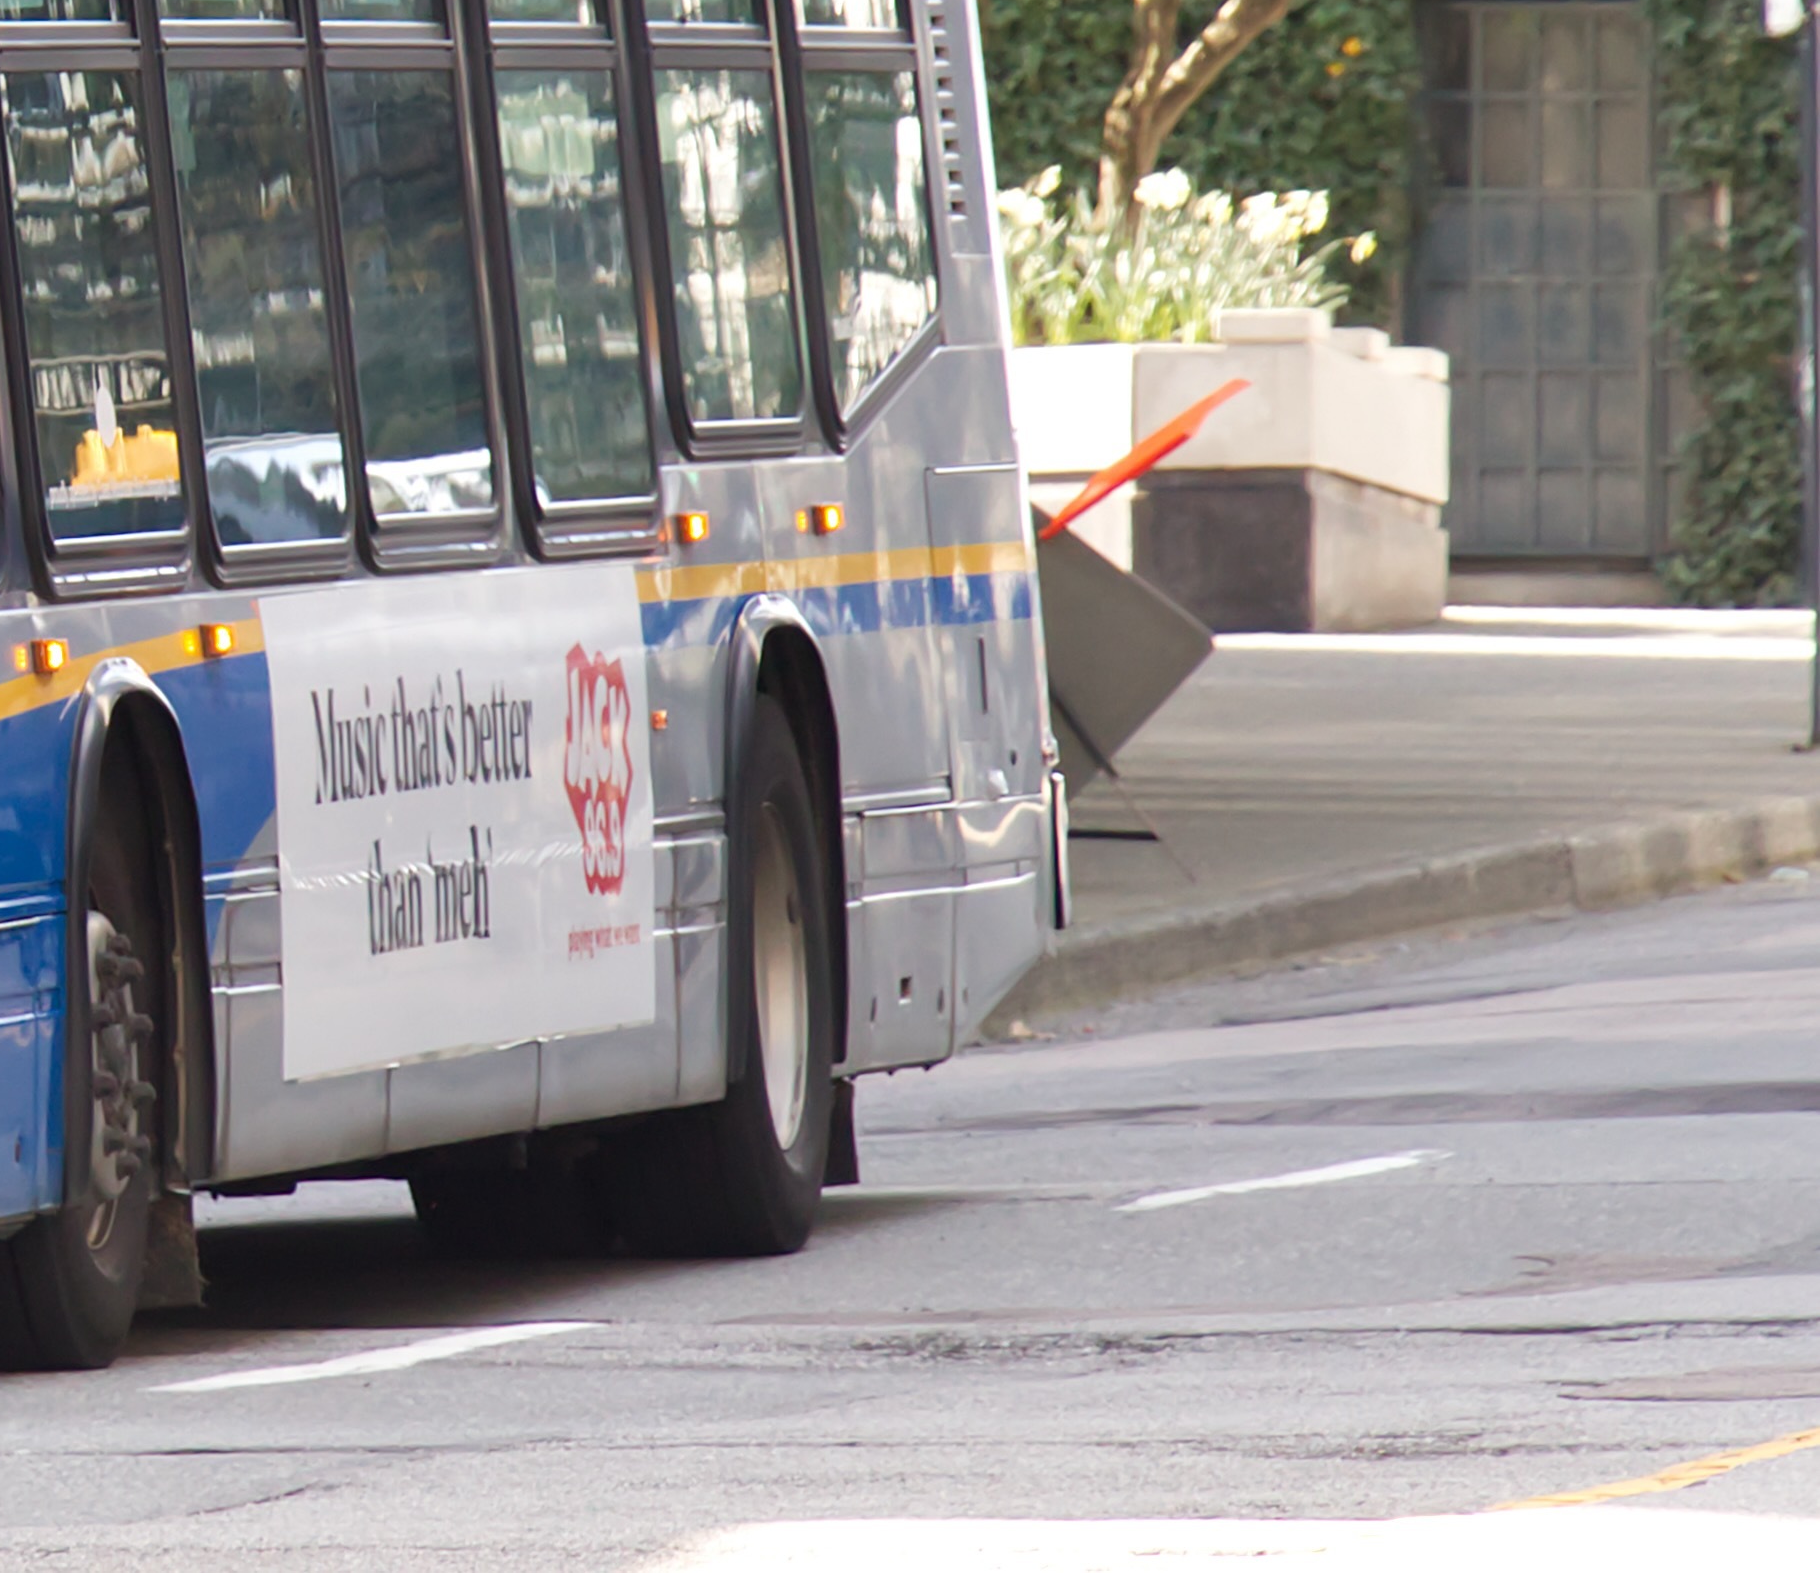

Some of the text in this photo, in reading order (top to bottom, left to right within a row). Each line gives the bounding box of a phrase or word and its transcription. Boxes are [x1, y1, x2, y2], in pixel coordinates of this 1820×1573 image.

[311, 668, 533, 805] Music that's better
[566, 666, 630, 797] JACK
[369, 839, 423, 956] than
